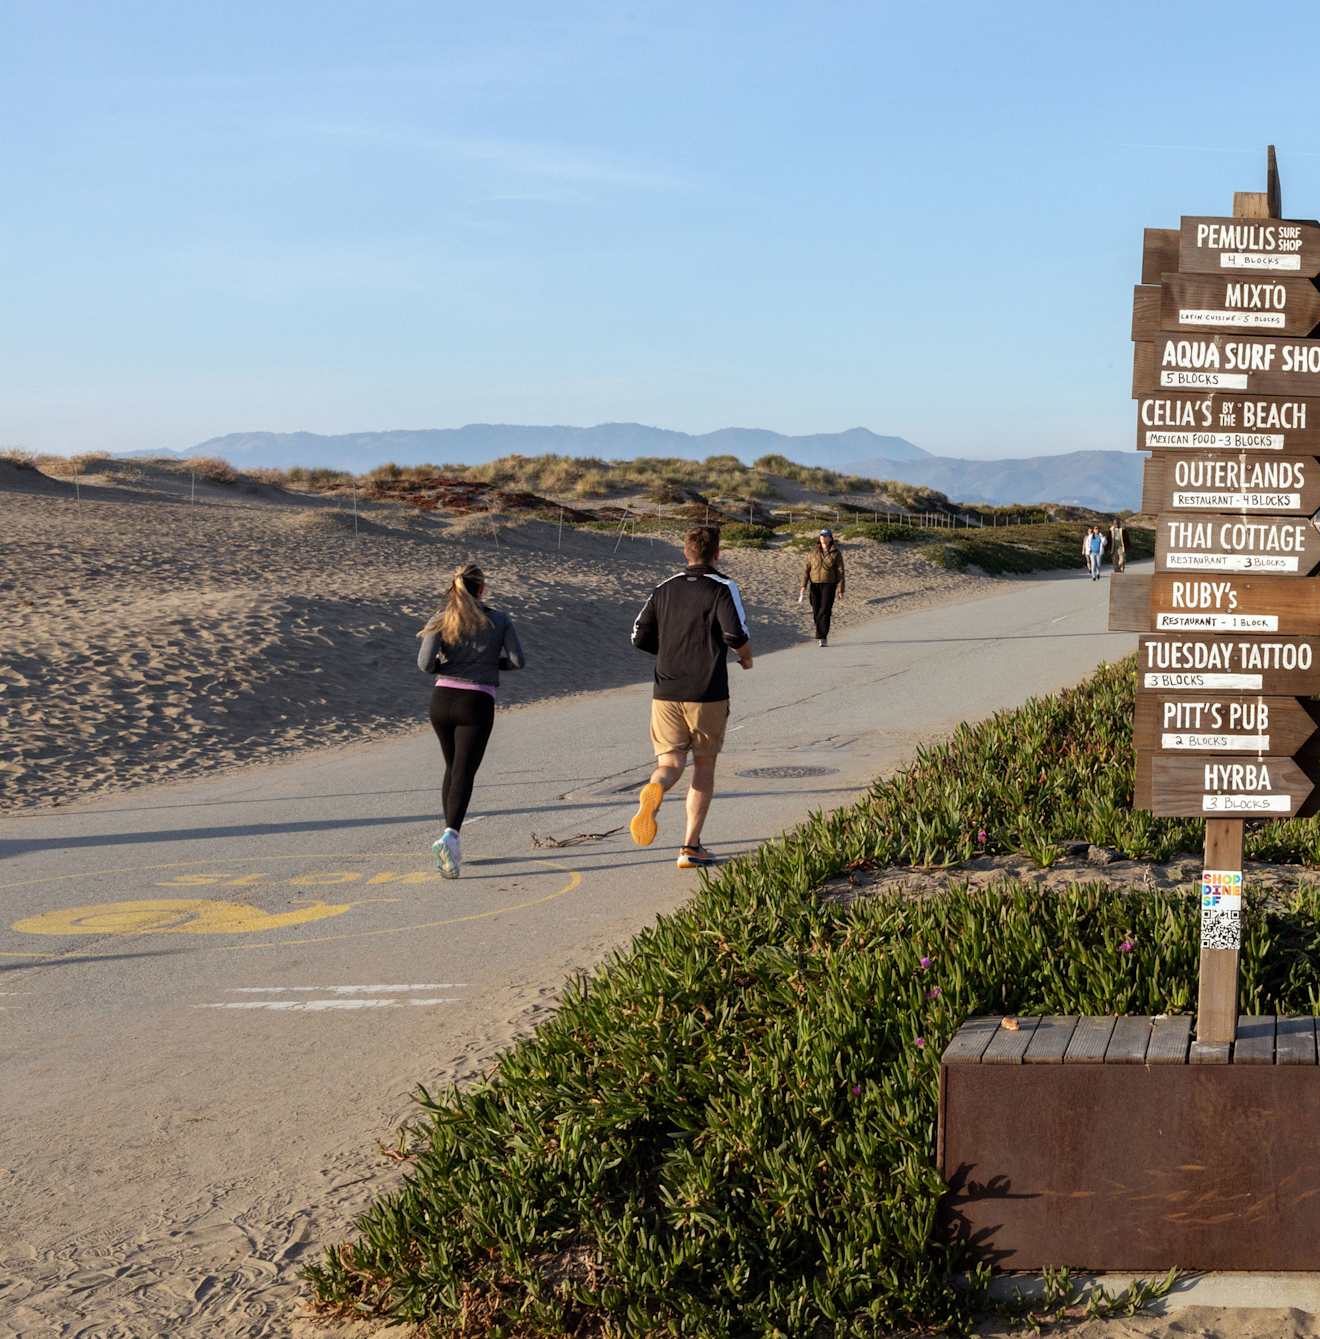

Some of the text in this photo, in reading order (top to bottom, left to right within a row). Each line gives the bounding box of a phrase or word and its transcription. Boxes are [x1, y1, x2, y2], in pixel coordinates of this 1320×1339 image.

[1197, 224, 1301, 250] PEMULIS SURF
[1278, 239, 1302, 251] SHOP
[1228, 255, 1236, 264] 4
[1225, 284, 1286, 309] MIXTO
[1162, 340, 1220, 368] AQUA
[1225, 343, 1276, 371] SURF
[1166, 373, 1219, 385] 5 BLOCKS
[1141, 399, 1307, 429] CELIA'S BY BEACH
[1219, 414, 1236, 427] THE
[1150, 433, 1190, 445] MEXICAN
[1192, 434, 1216, 445] FOOD
[1235, 436, 1272, 448] BLOCKS
[1175, 461, 1305, 489] OUTERLANDS
[1178, 494, 1234, 506] RESTAURANT
[1252, 495, 1291, 507] BLOCKS
[1168, 522, 1306, 551] THAI COTTAGE
[1170, 556, 1228, 565] RESTAURANT
[1244, 557, 1252, 568] 3
[1162, 615, 1217, 627] RESTAURANT
[1240, 619, 1269, 628] BLOCK
[1145, 641, 1313, 671] TUESDAY TATTOO
[1150, 674, 1204, 687] 3 BLOCKS
[1164, 702, 1269, 730] PITT'S PUB
[1175, 736, 1183, 746] 2
[1204, 764, 1272, 790] HYRBA
[1206, 797, 1217, 810] 3
[1203, 874, 1240, 883] SHOP
[1203, 885, 1241, 896] DINE
[1203, 896, 1221, 906] SF
